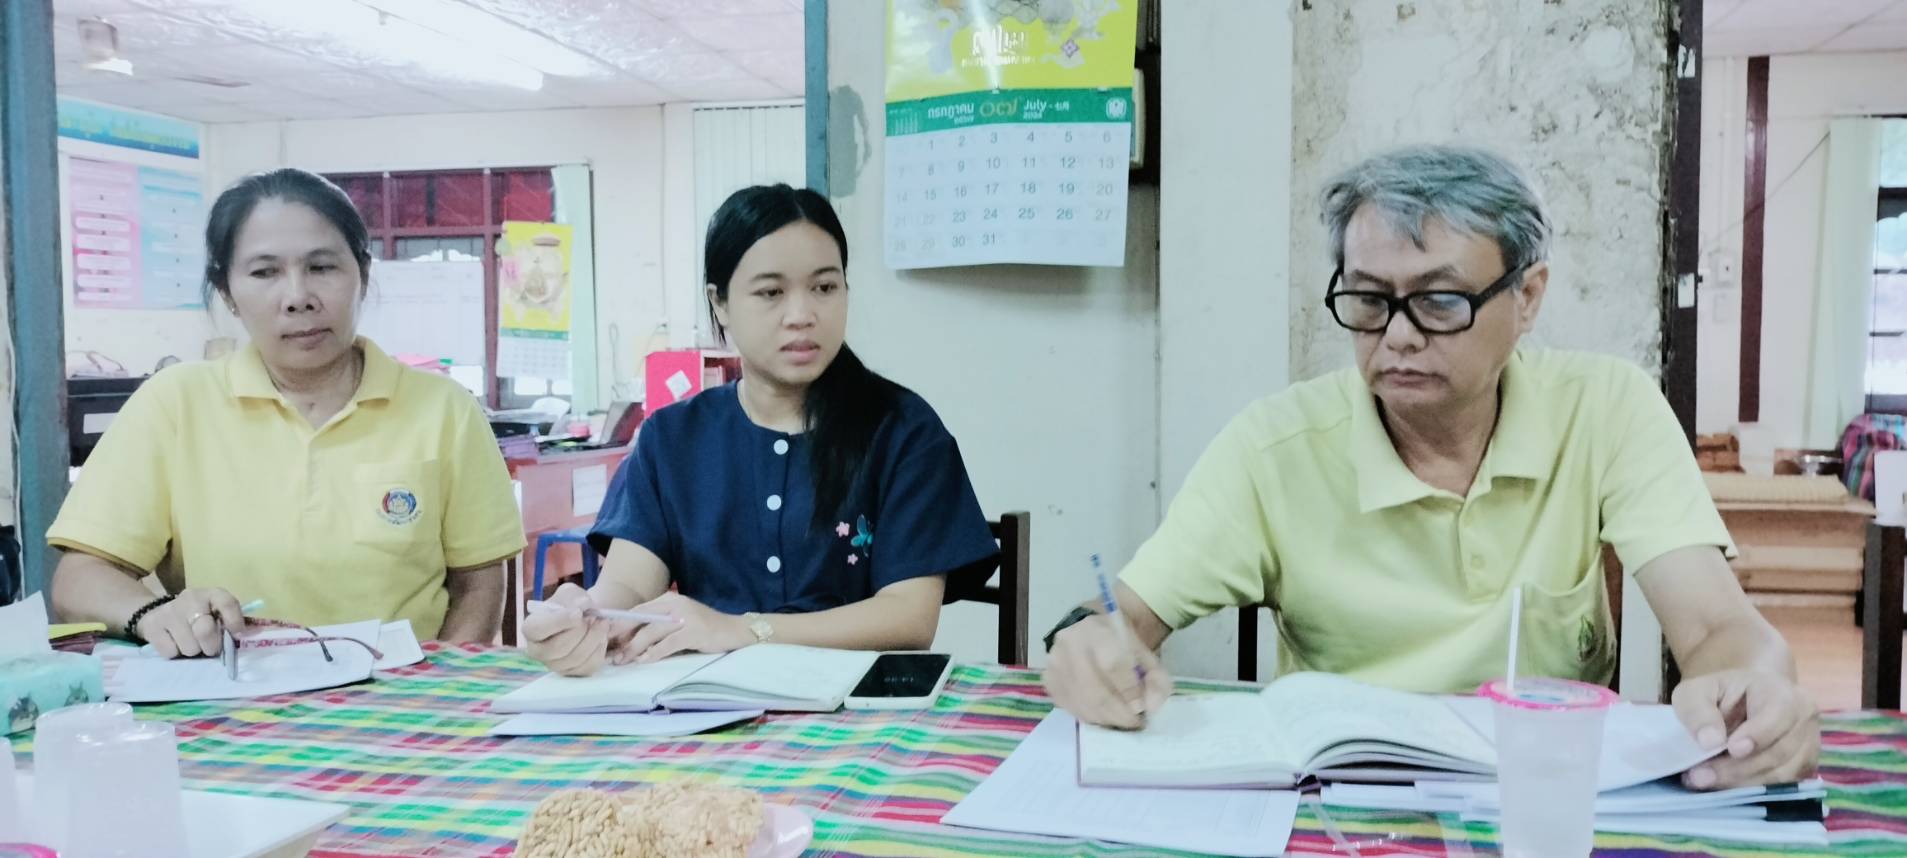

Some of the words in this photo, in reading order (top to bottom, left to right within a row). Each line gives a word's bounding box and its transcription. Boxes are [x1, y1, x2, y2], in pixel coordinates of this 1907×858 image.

[928, 103, 974, 120] กรกฎาคม
[1023, 98, 1047, 112] July
[958, 135, 966, 148] 2
[990, 131, 997, 144] 3
[1027, 131, 1034, 142] 4
[1065, 131, 1072, 143] 5
[1103, 131, 1111, 143] 6
[928, 162, 935, 176] 8
[958, 160, 965, 173] 9
[986, 156, 1000, 169] 10
[1023, 156, 1036, 168] 11
[1061, 156, 1076, 169] 12
[1099, 157, 1114, 169] 13
[896, 191, 908, 205] 14
[925, 188, 936, 200] 15
[954, 185, 967, 198] 16
[985, 182, 999, 195] 17
[1021, 182, 1036, 194] 18
[1059, 182, 1074, 195] 19
[1096, 183, 1113, 196] 20
[952, 209, 966, 223] 23
[983, 207, 998, 220] 24
[1018, 207, 1035, 220] 25
[1056, 207, 1073, 220] 26
[1095, 208, 1111, 221] 27
[952, 235, 965, 248] 30
[982, 232, 995, 246] 31
